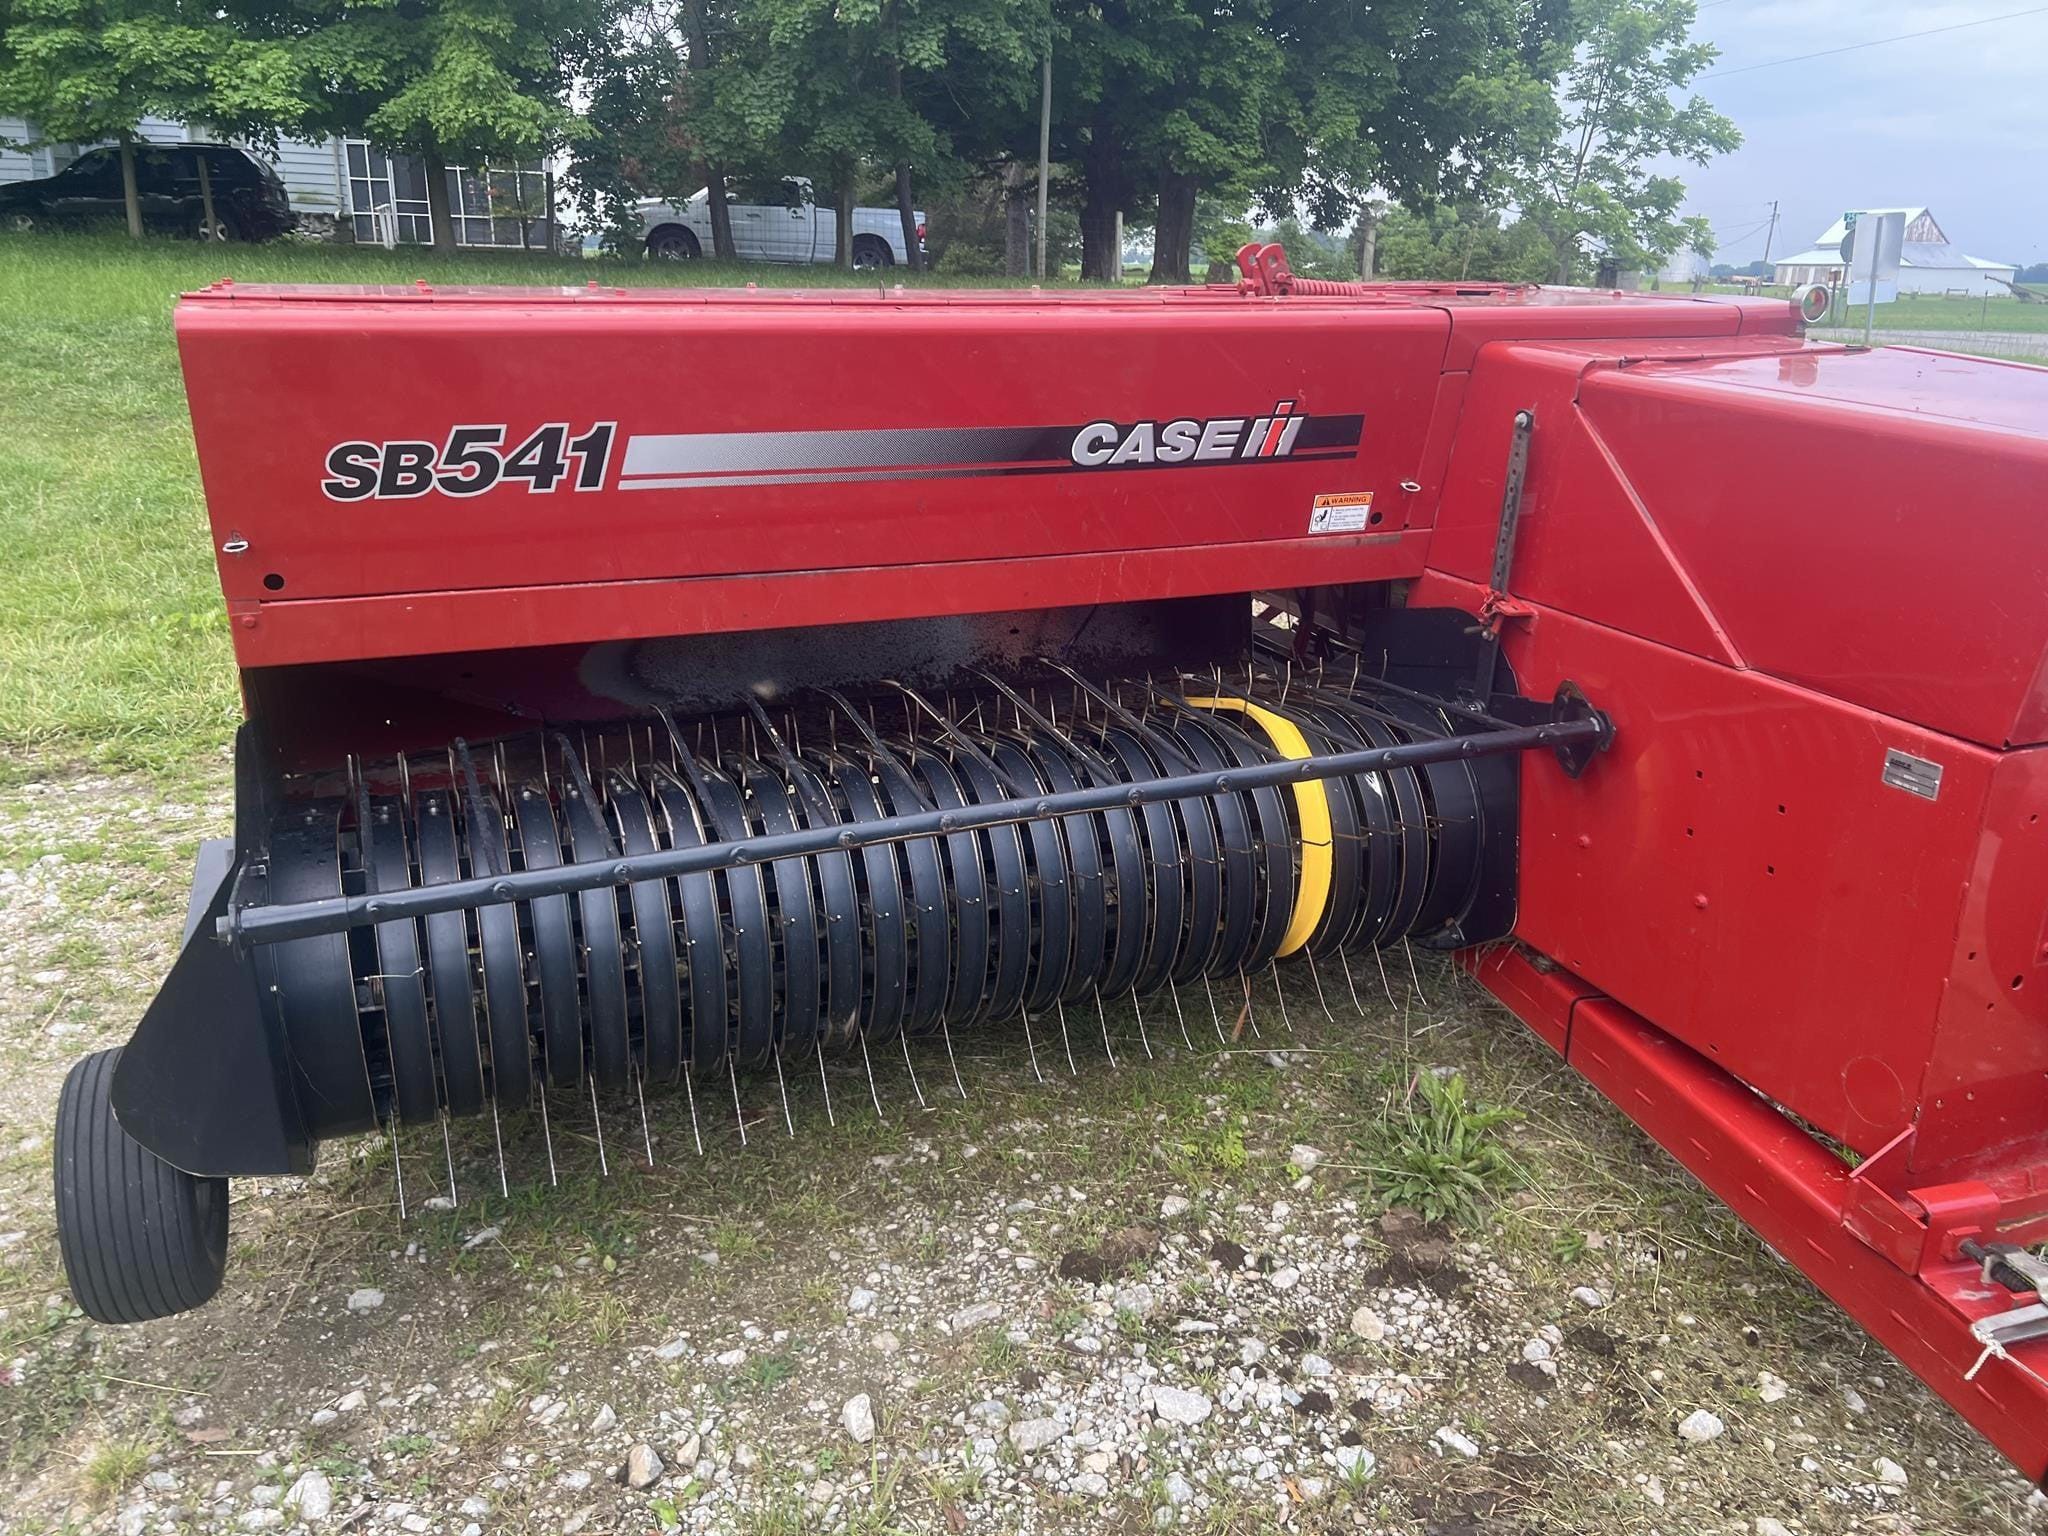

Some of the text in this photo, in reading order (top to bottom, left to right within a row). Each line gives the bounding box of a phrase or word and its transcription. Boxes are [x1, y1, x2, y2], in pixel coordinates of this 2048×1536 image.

[322, 421, 617, 501] SB541
[1071, 419, 1245, 465] CASE
[1331, 496, 1367, 504] WARNING
